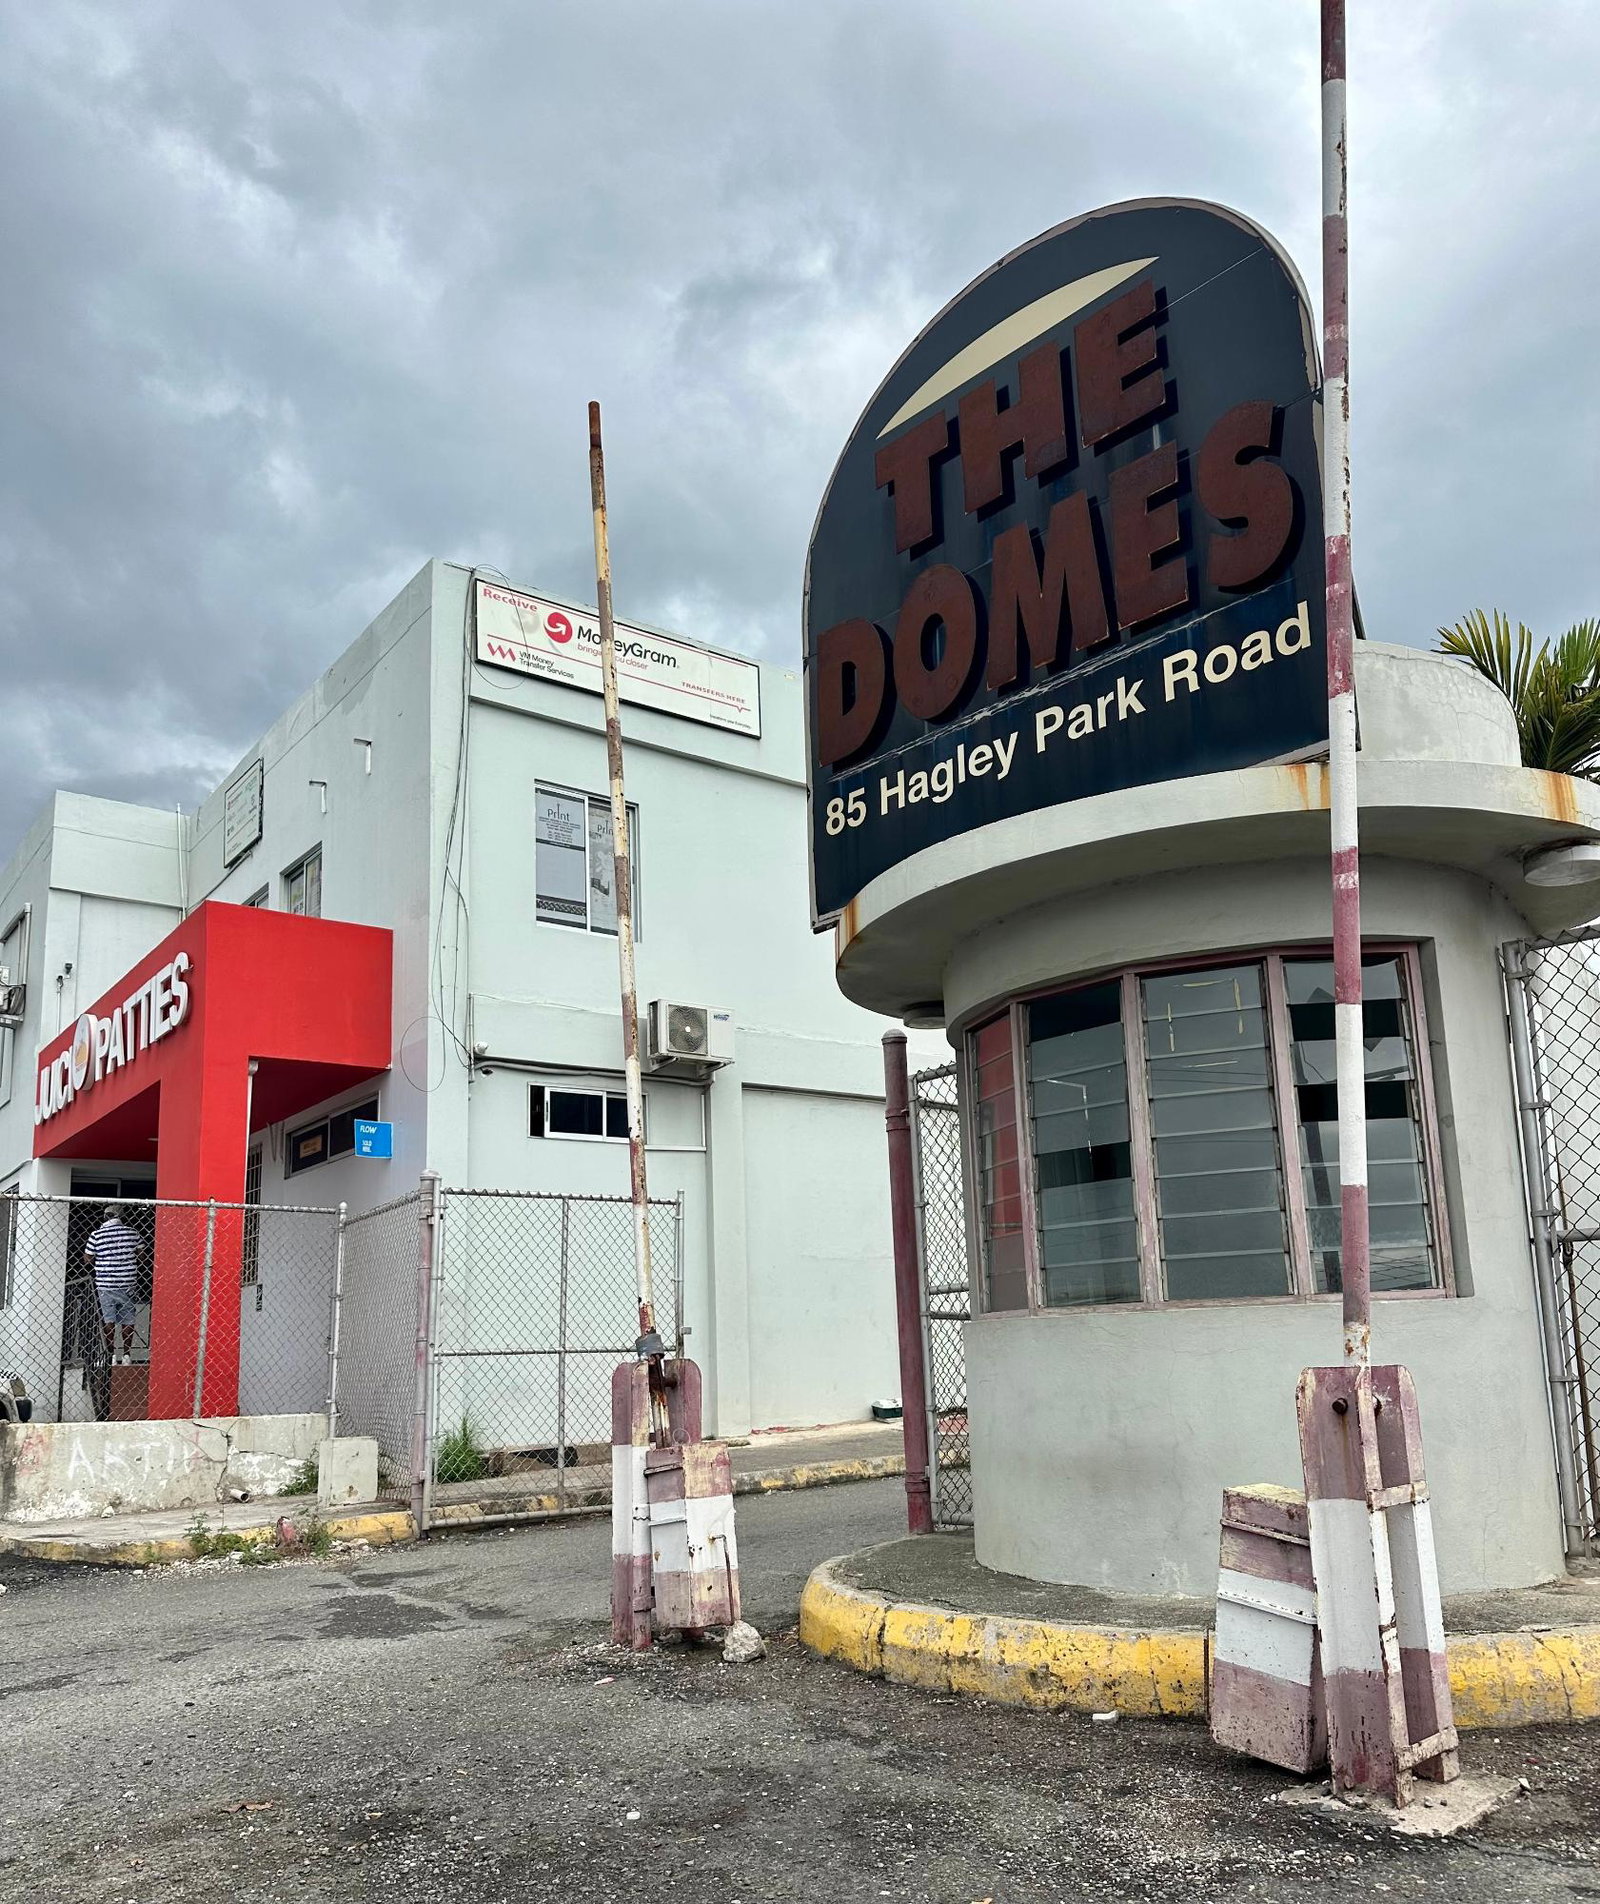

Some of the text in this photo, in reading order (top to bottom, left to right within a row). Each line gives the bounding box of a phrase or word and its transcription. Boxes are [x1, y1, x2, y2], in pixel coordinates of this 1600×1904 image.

[875, 278, 1167, 555] THE
[817, 401, 1294, 768] DOMES
[483, 588, 538, 612] Receive
[577, 625, 677, 668] MoeyGram
[531, 654, 555, 668] Money
[546, 665, 575, 679] Services
[682, 681, 746, 704] TRANSFERS HERE
[825, 600, 1313, 836] 85 Hagley Park Road
[597, 820, 614, 836] Prin
[34, 951, 190, 1126] JUICI PATTIES
[359, 1124, 378, 1134] FLOW
